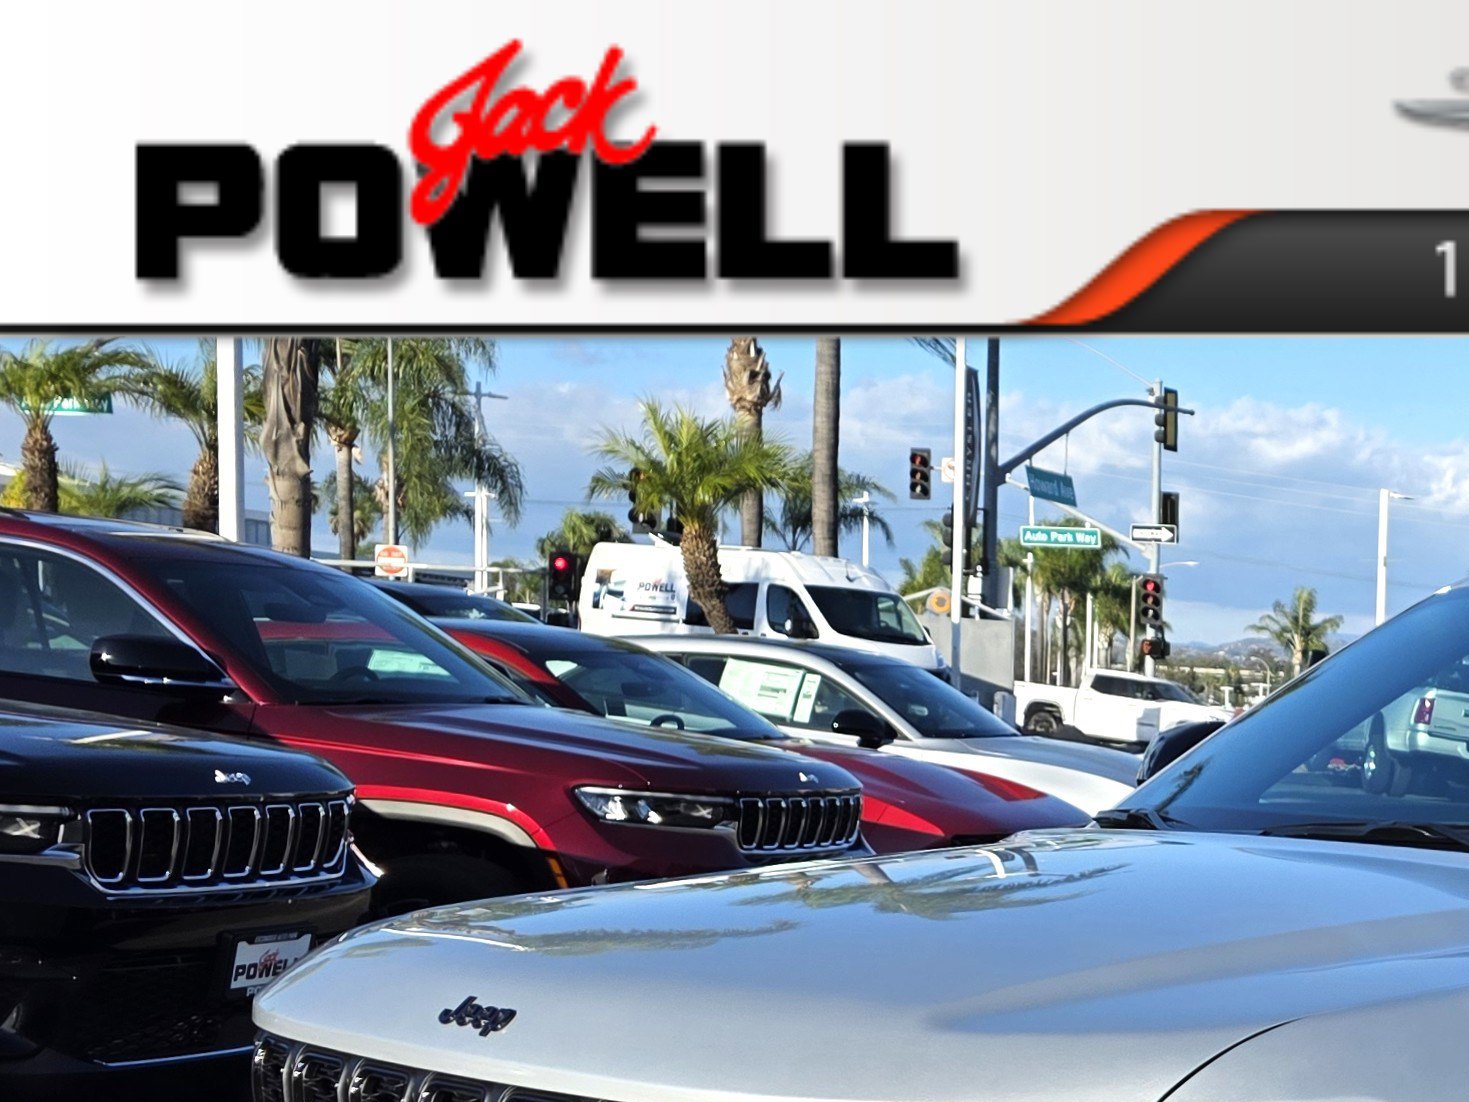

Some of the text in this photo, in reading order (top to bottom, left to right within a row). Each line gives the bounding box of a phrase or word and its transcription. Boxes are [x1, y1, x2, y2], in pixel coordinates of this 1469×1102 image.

[1024, 531, 1097, 545] Auto Park Way
[637, 581, 676, 593] POWELL
[233, 957, 299, 982] POWEL
[438, 995, 518, 1038] Jeep
